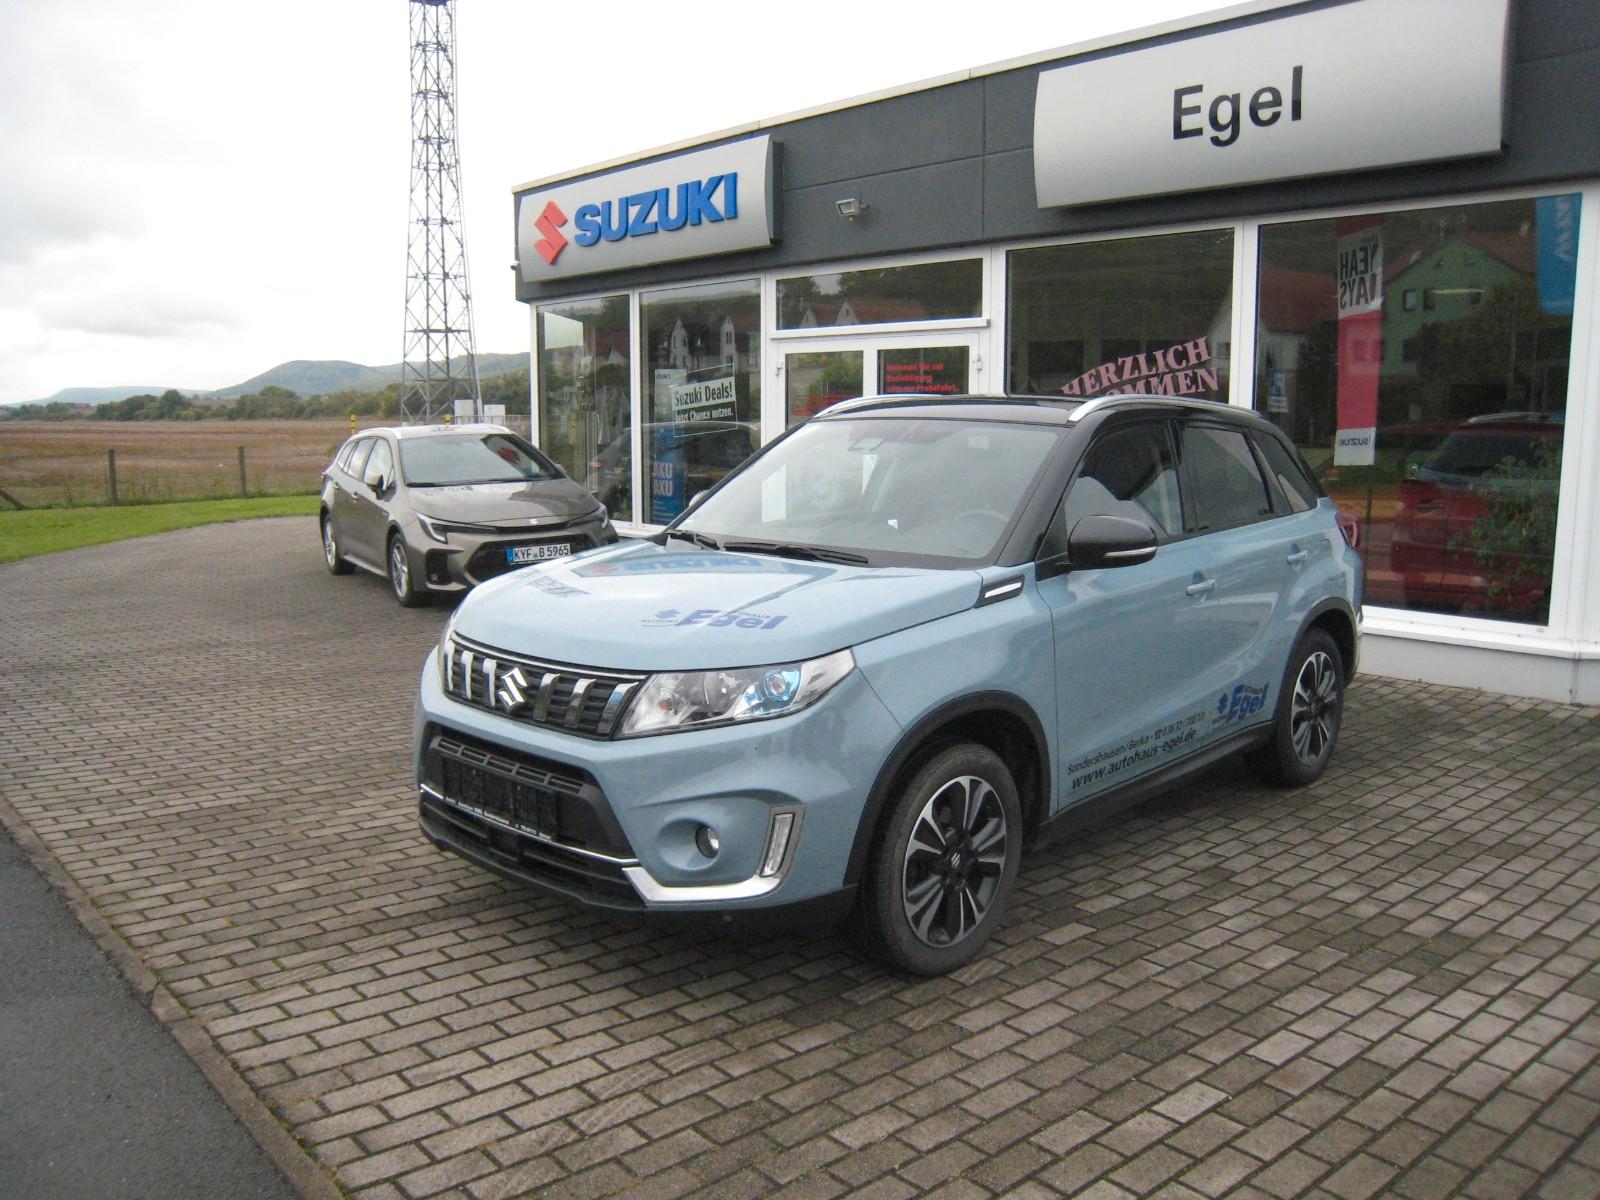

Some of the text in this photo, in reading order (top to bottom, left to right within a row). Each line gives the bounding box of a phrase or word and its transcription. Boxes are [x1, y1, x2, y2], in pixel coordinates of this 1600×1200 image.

[1173, 65, 1303, 147] Egel
[574, 171, 738, 247] SUZUKI
[1060, 336, 1211, 395] HERZLICH
[674, 381, 733, 407] Suzuki Deals!
[514, 544, 569, 560] KYF B 5965
[1226, 682, 1270, 721] Egel
